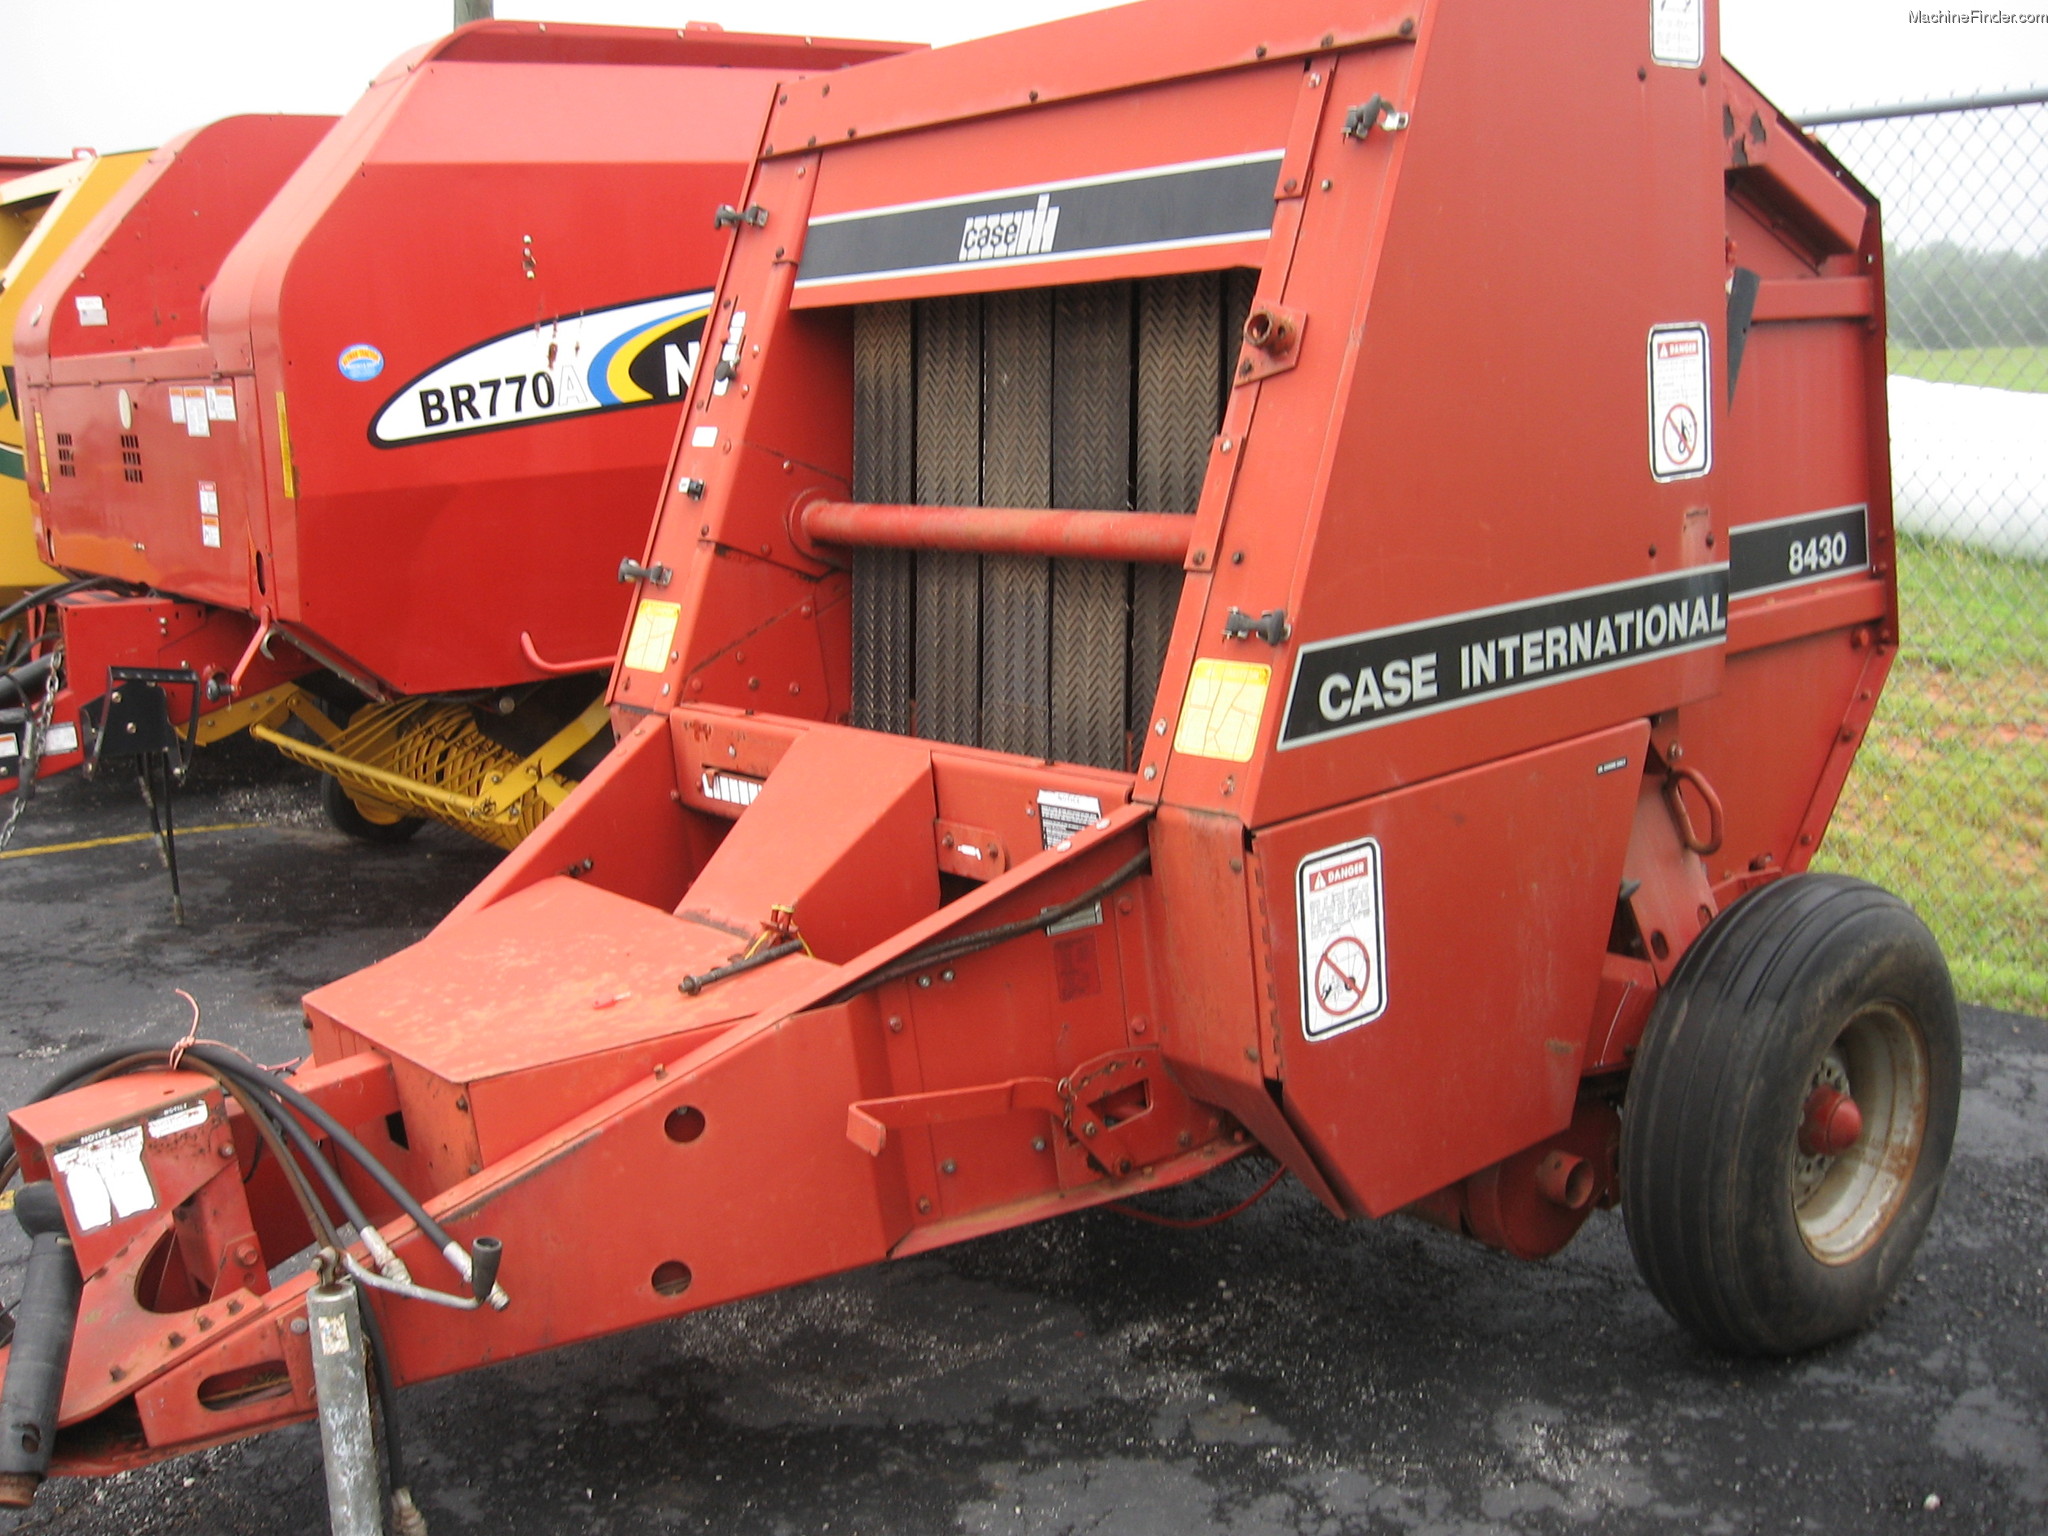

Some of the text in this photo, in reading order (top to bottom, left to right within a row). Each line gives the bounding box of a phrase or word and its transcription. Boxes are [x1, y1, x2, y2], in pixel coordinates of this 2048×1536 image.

[1788, 531, 1847, 575] 8430
[1319, 594, 1727, 722] CASE INTERNATIONAL
[1327, 861, 1365, 884] DANGER
